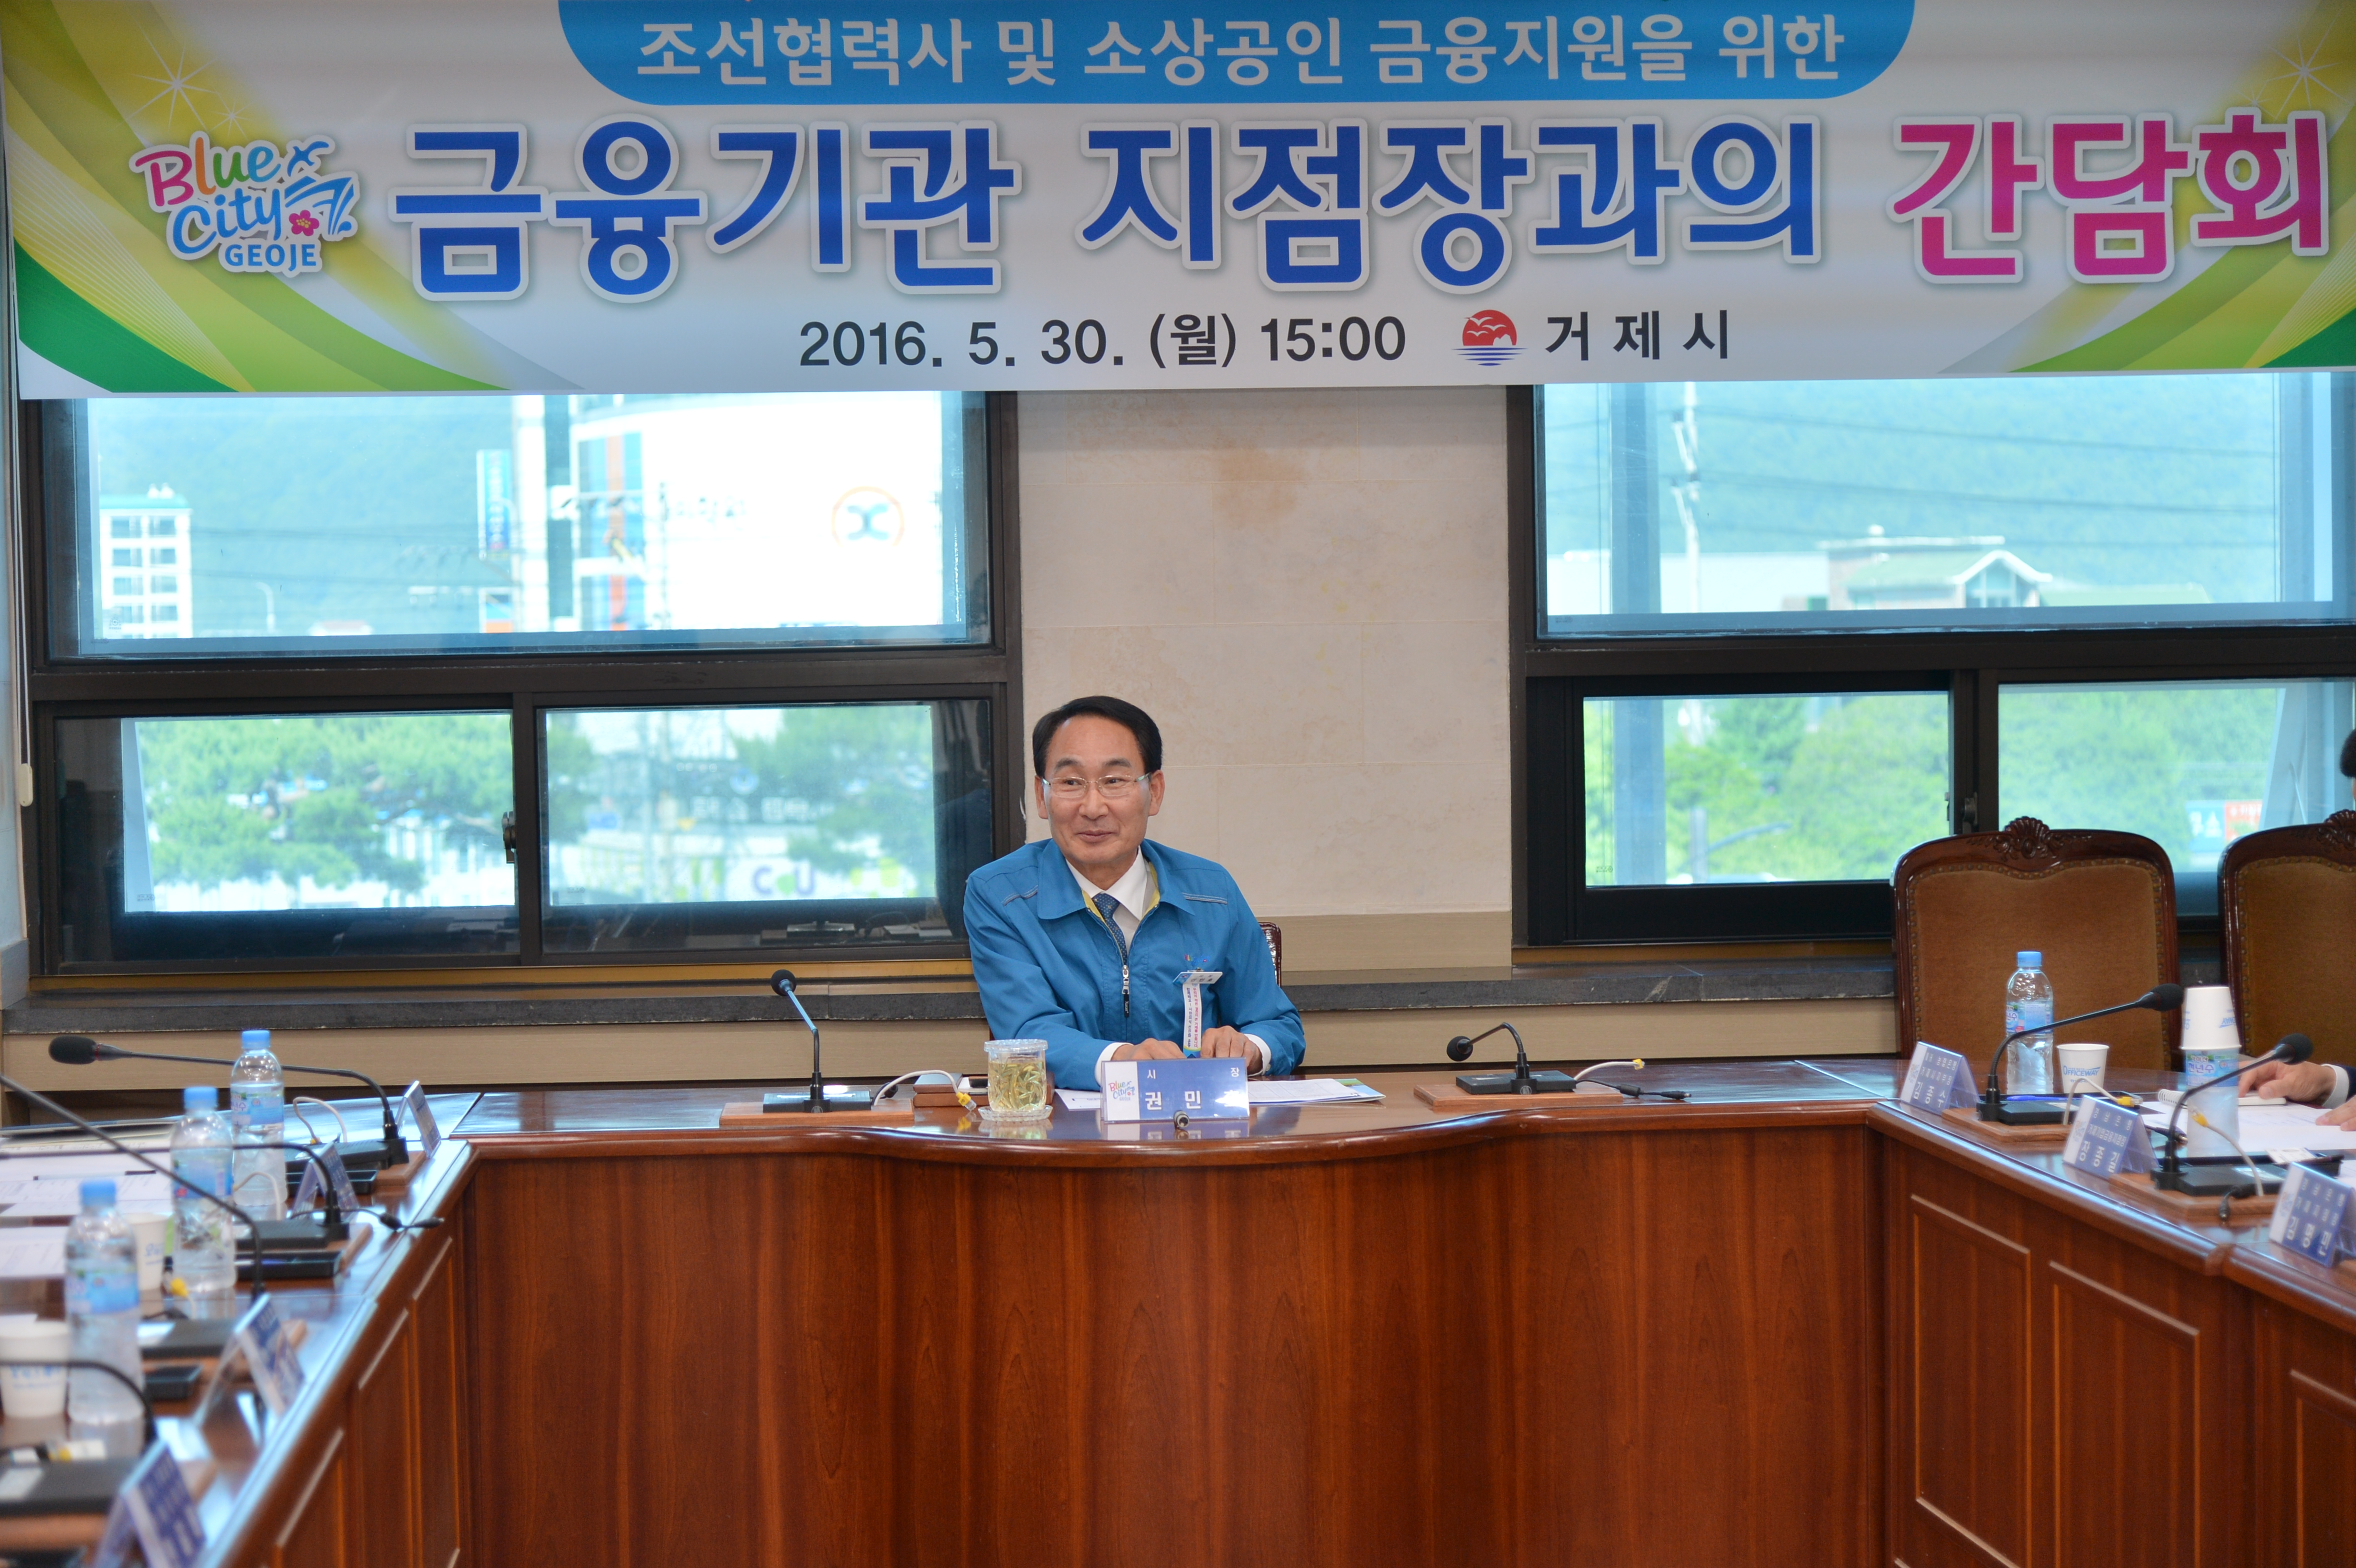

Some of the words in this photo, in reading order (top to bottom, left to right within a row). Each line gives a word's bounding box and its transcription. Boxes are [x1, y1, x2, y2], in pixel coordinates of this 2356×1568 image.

[638, 18, 971, 85] 조선협력사
[998, 18, 1056, 86] 및
[1084, 17, 1343, 86] 소상공인
[1370, 15, 1692, 84] 금융지원을
[1719, 14, 1845, 81] 위한
[135, 136, 282, 207] Blue
[396, 121, 1014, 295] 금융기관
[1083, 122, 1822, 286] 지점장과의
[1894, 115, 2330, 276] 간담회
[173, 187, 282, 254] City
[224, 244, 317, 272] GEOJE
[800, 321, 942, 367] 2016.
[969, 321, 1015, 367] 5.
[1041, 319, 1123, 366] 30.
[1150, 313, 1236, 369] (월)
[1261, 316, 1406, 362] 15:00
[2063, 1065, 2100, 1077] OFFICEWAY
